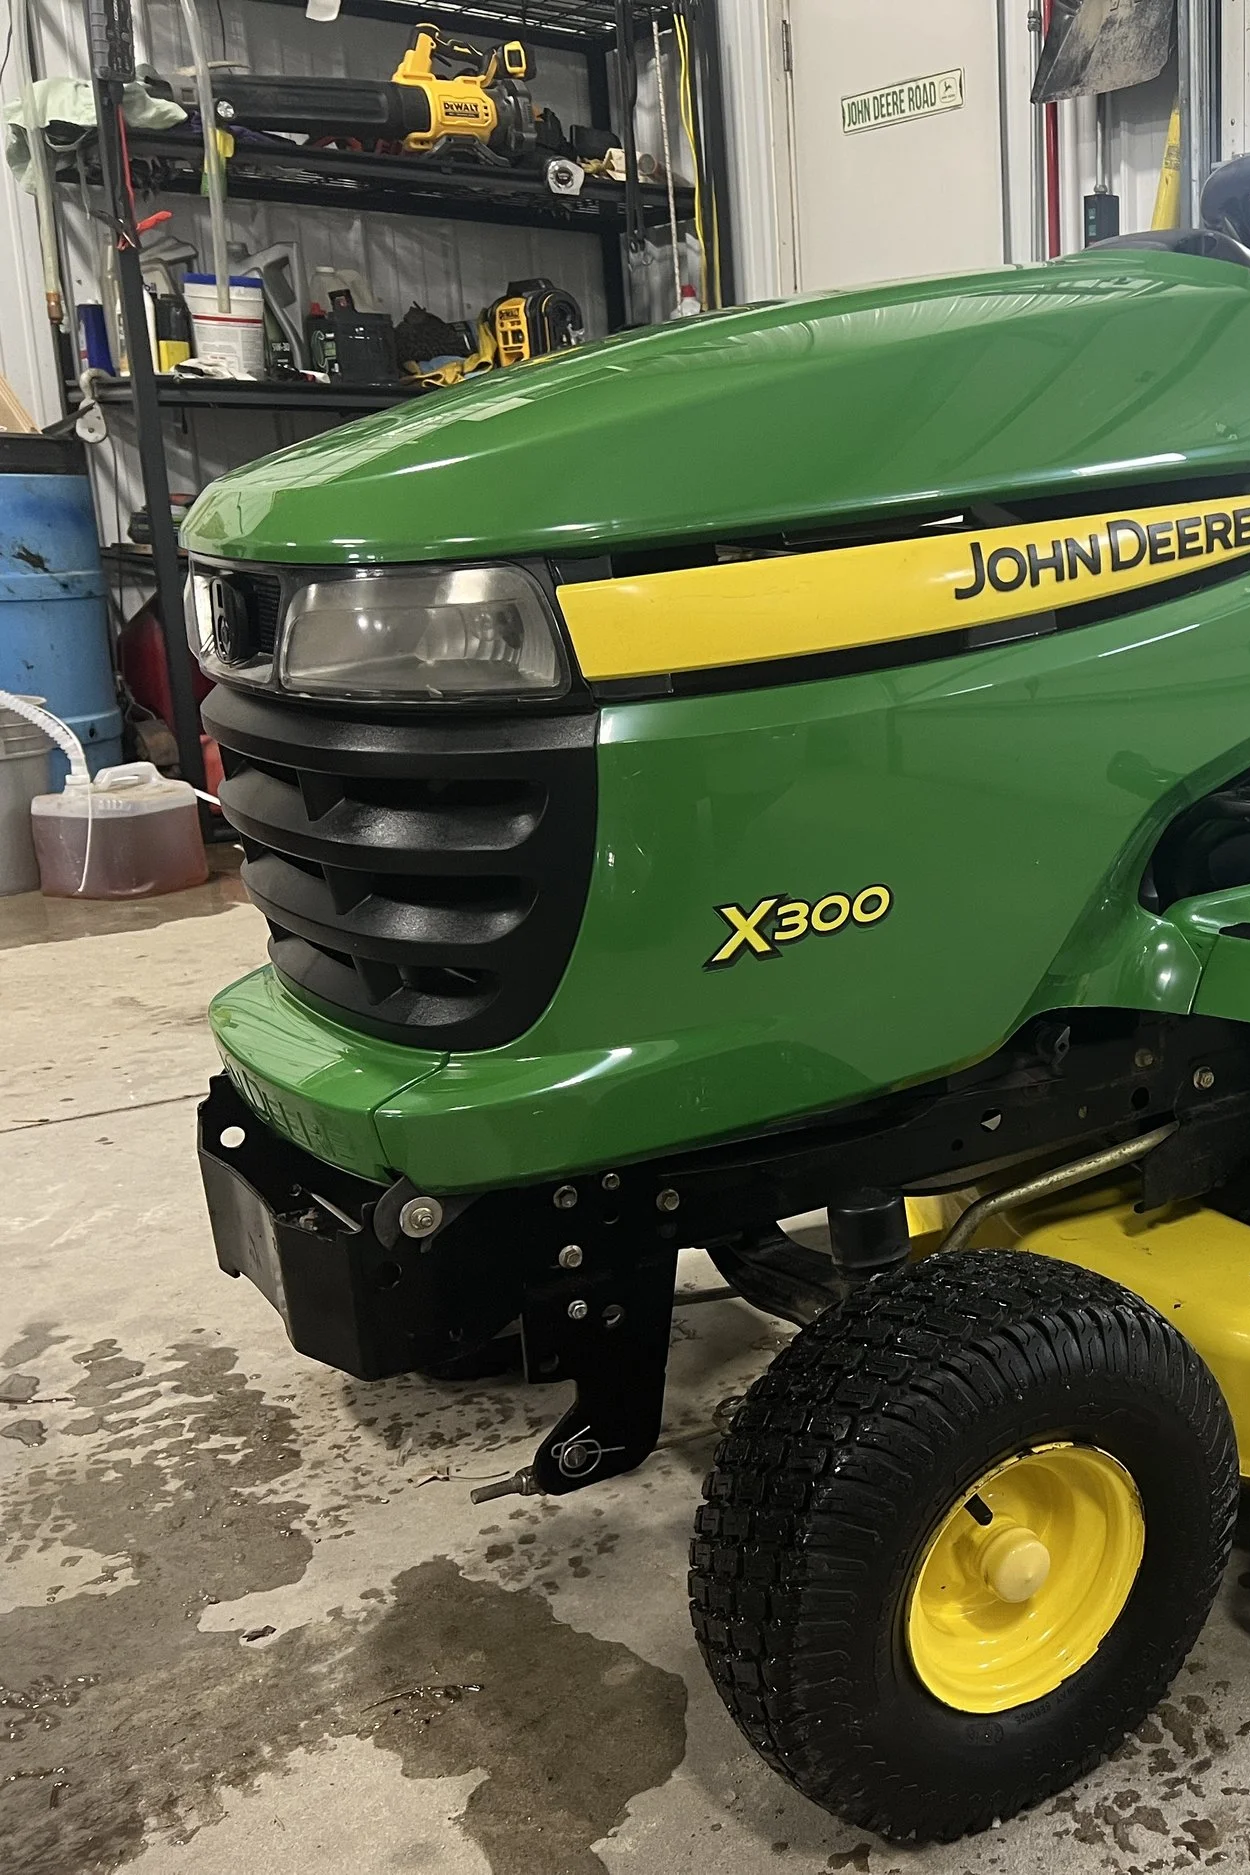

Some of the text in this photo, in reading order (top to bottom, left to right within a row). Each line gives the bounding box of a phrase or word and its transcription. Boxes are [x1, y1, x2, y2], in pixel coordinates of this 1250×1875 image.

[847, 81, 937, 127] JOHN DEERE ROAD
[954, 534, 1101, 600] JOHN
[703, 884, 893, 970] X300
